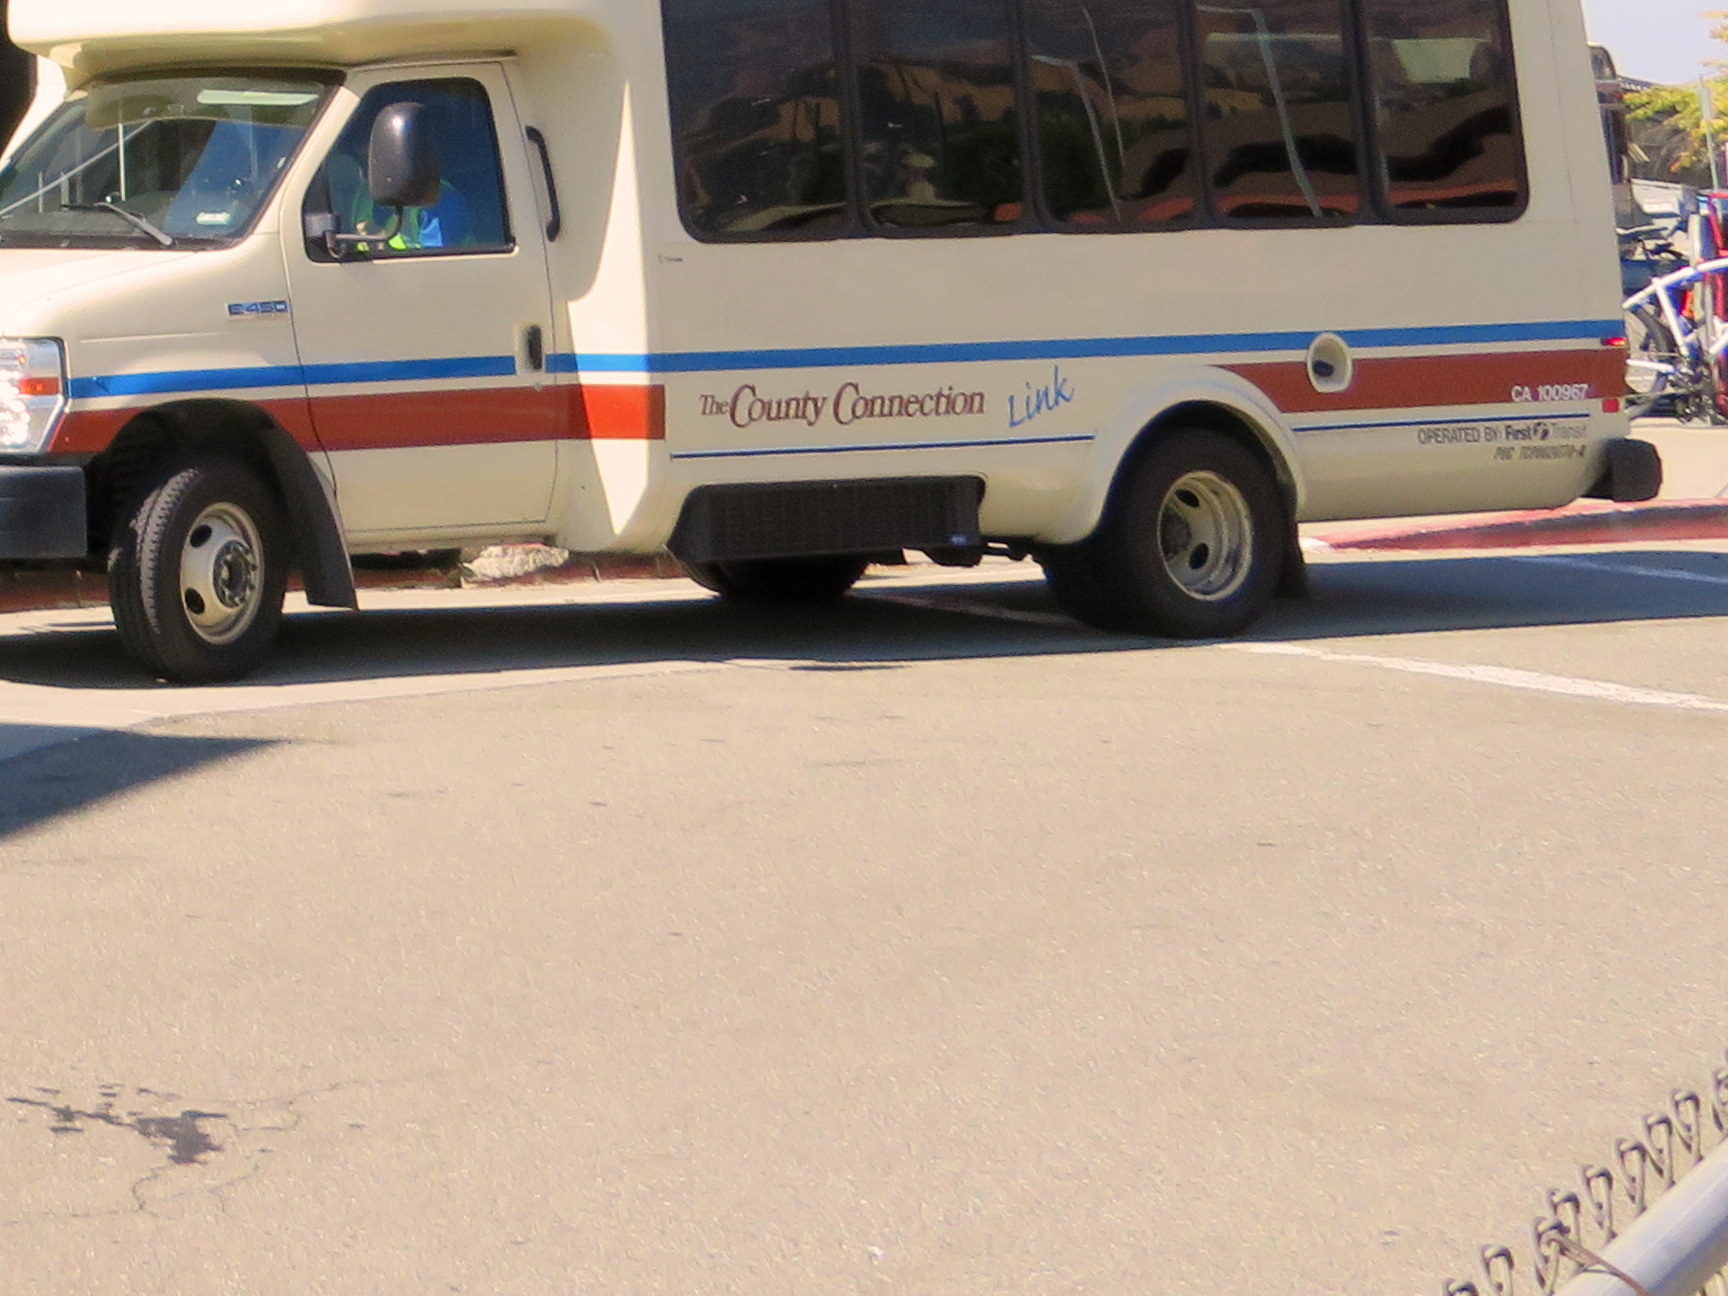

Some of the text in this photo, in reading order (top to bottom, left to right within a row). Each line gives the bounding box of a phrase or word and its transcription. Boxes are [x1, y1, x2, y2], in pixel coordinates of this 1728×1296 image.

[700, 381, 986, 428] The County Connection
[1007, 364, 1076, 428] Link
[1510, 385, 1532, 402] CA
[1417, 426, 1480, 444] OPERATED
[1504, 424, 1532, 441] First
